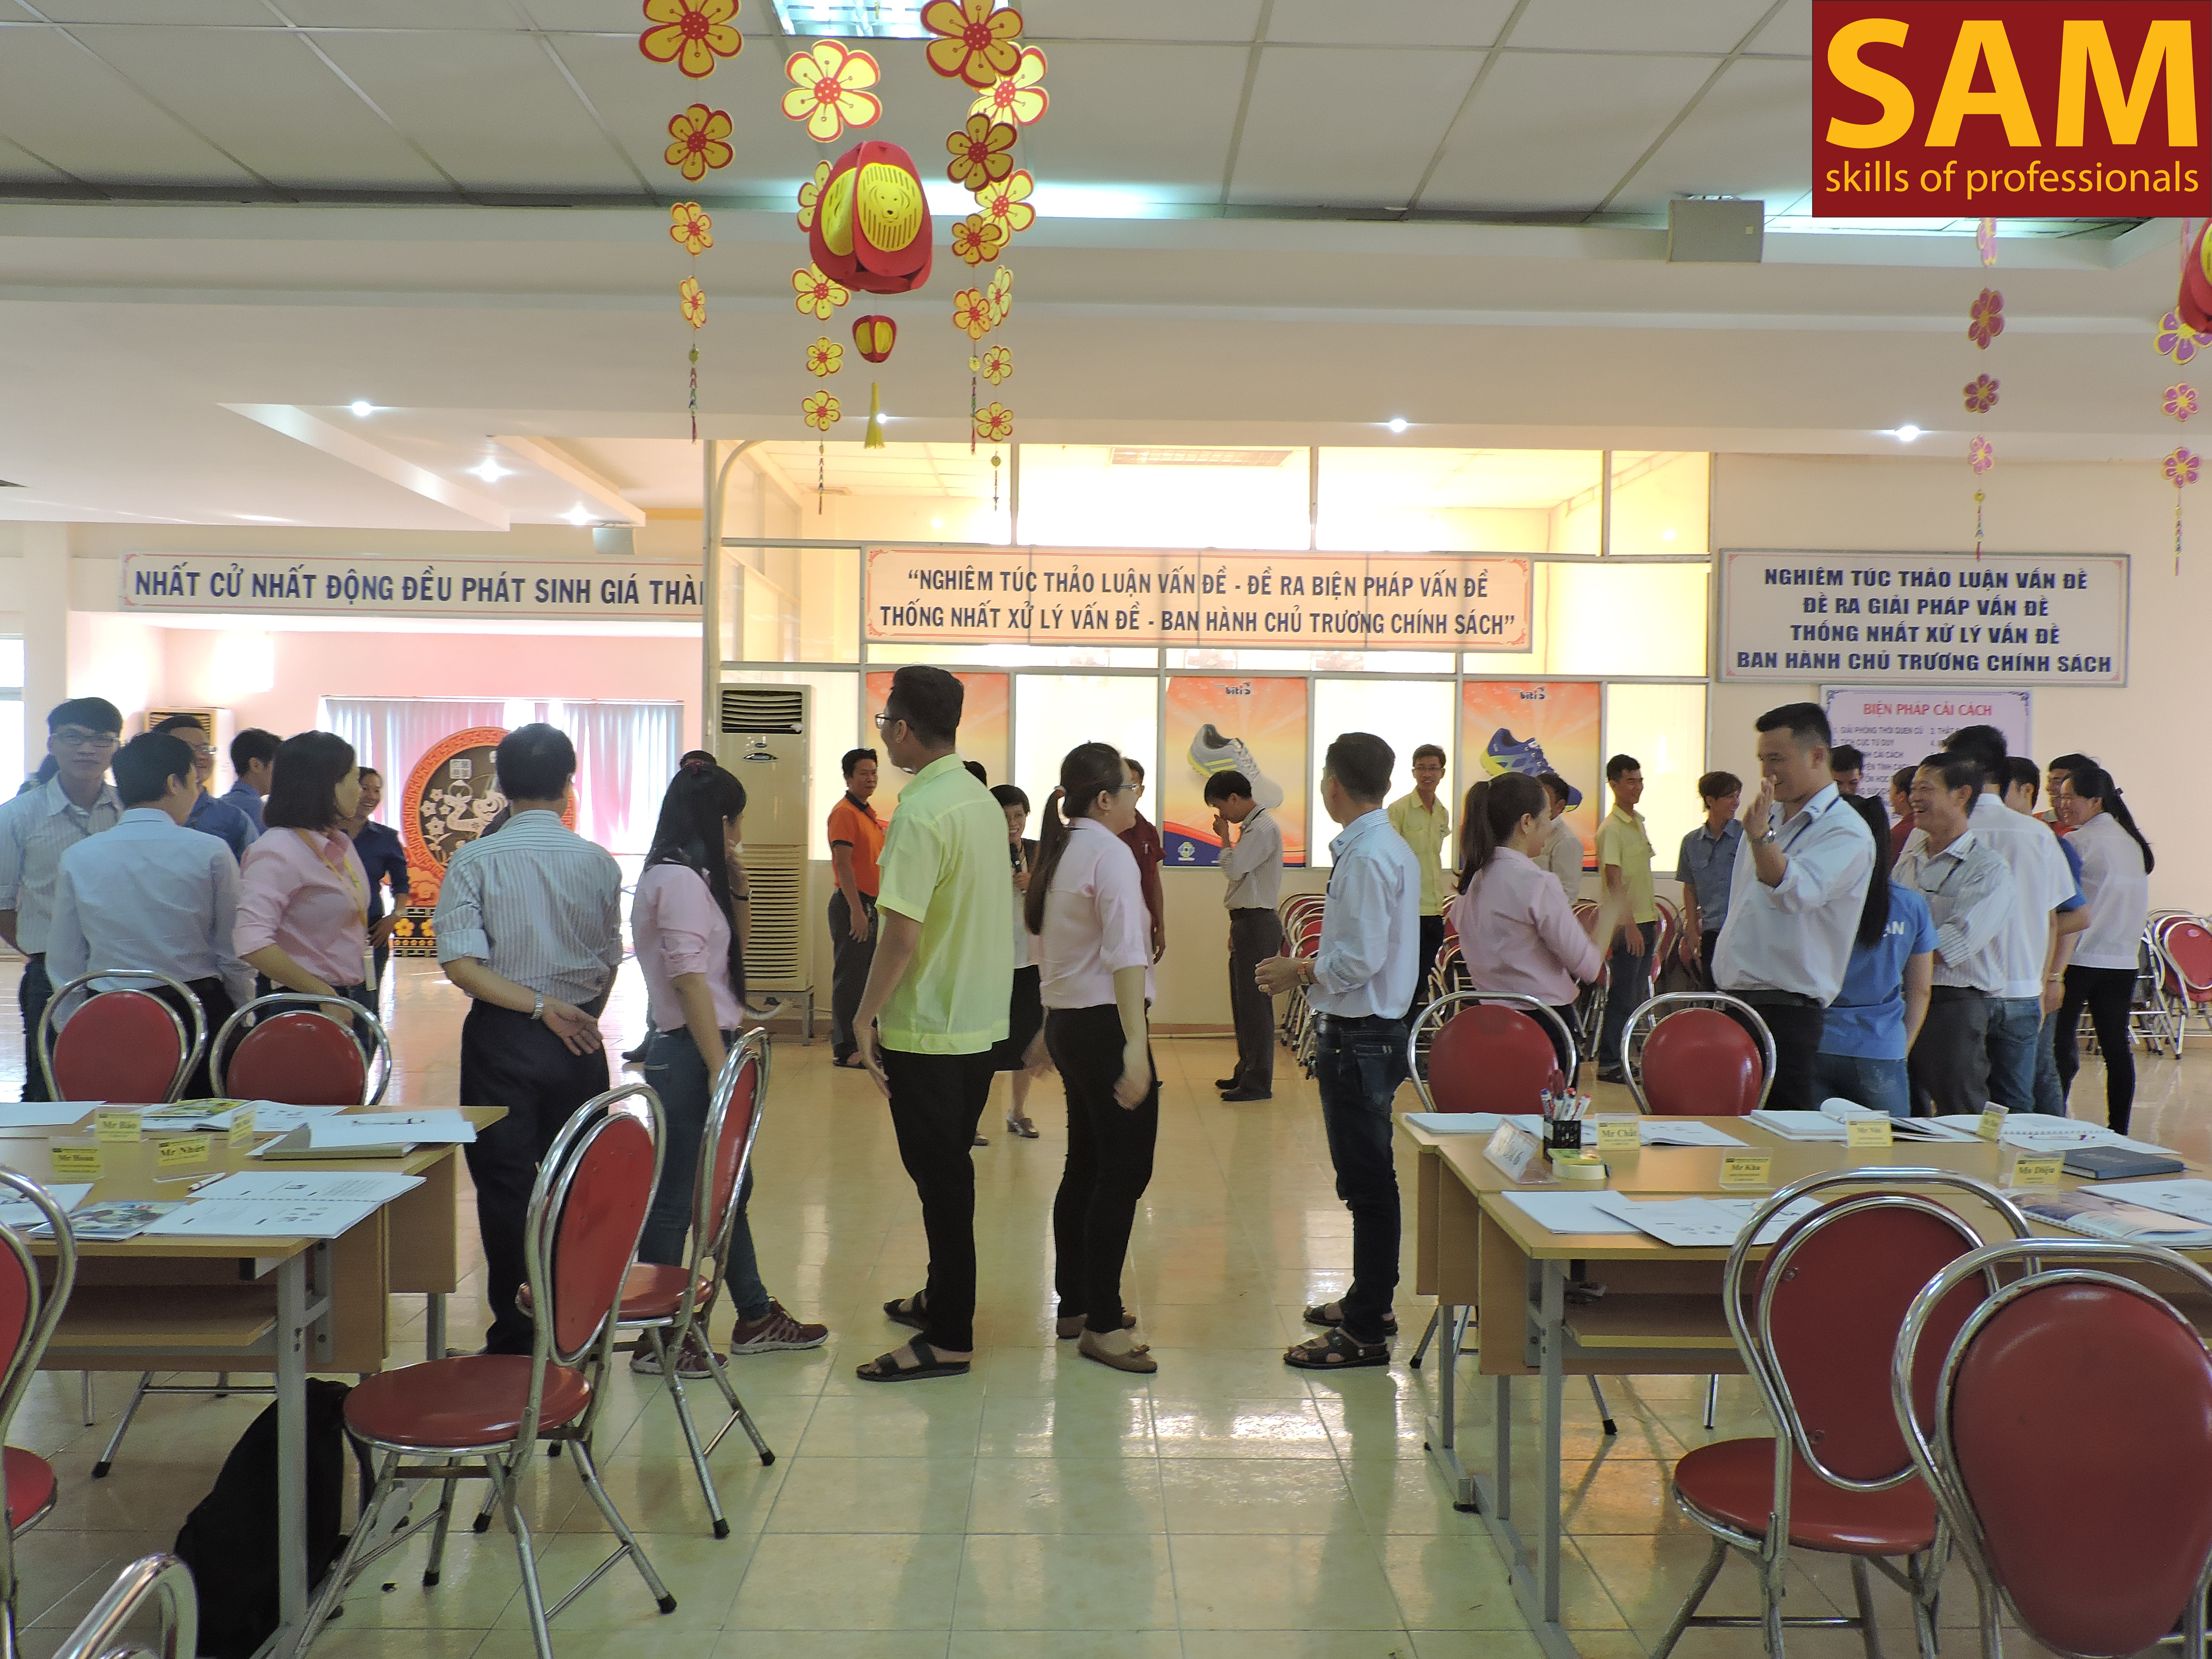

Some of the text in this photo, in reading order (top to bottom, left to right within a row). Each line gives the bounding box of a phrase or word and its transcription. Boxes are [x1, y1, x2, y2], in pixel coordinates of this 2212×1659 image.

[135, 562, 201, 596] NHẤT
[210, 563, 244, 597] CỬ
[252, 564, 317, 599] NHẤT
[326, 568, 394, 605] ĐỘNG
[402, 565, 452, 601] ĐỀU
[462, 571, 526, 602] PHÁT
[535, 578, 591, 603] SINH
[601, 573, 639, 604] GIÁ
[1000, 566, 1037, 591] TÚC
[1044, 565, 1094, 593] THẢO
[1102, 567, 1151, 597] LUẬN
[1157, 565, 1195, 594] VẤN
[1202, 565, 1226, 594] ĐỀ
[1248, 566, 1273, 595] ĐỀ
[1281, 576, 1304, 596] RA
[1312, 571, 1356, 600] BIỆN
[1363, 571, 1413, 597] PHÁP
[1420, 569, 1457, 598] VẤN
[1464, 568, 1489, 598] ĐỀ
[1765, 566, 2088, 591] NGHIÊM TÚC THẢO LUẬN VẤN ĐỀ
[880, 598, 943, 626] THỐNG
[951, 600, 1000, 628] NHẤT
[1008, 601, 1034, 629] XỬ
[1041, 603, 1063, 629] LÝ
[1071, 601, 1108, 630] VẤN
[1116, 601, 1140, 630] ĐỀ
[1162, 610, 1199, 631] BAN
[1206, 606, 1257, 632] HÀNH
[1265, 604, 1302, 633] CHỦ
[1310, 609, 1384, 634] TRƯƠNG
[1392, 608, 1447, 634] CHÍNH
[1803, 592, 2049, 616] ĐỀ RA GIẢI PHÁP VẤN ĐỀ
[1790, 620, 2060, 644] THỐNG NHẤT XỬ LÝ VẤN ĐỀ
[1737, 649, 2111, 673] BAN HÀNH CHỦ TRƯƠNG CHÍNH SÁCH
[1863, 700, 1992, 717] BIỆN PHÁP CẢI CÁCH
